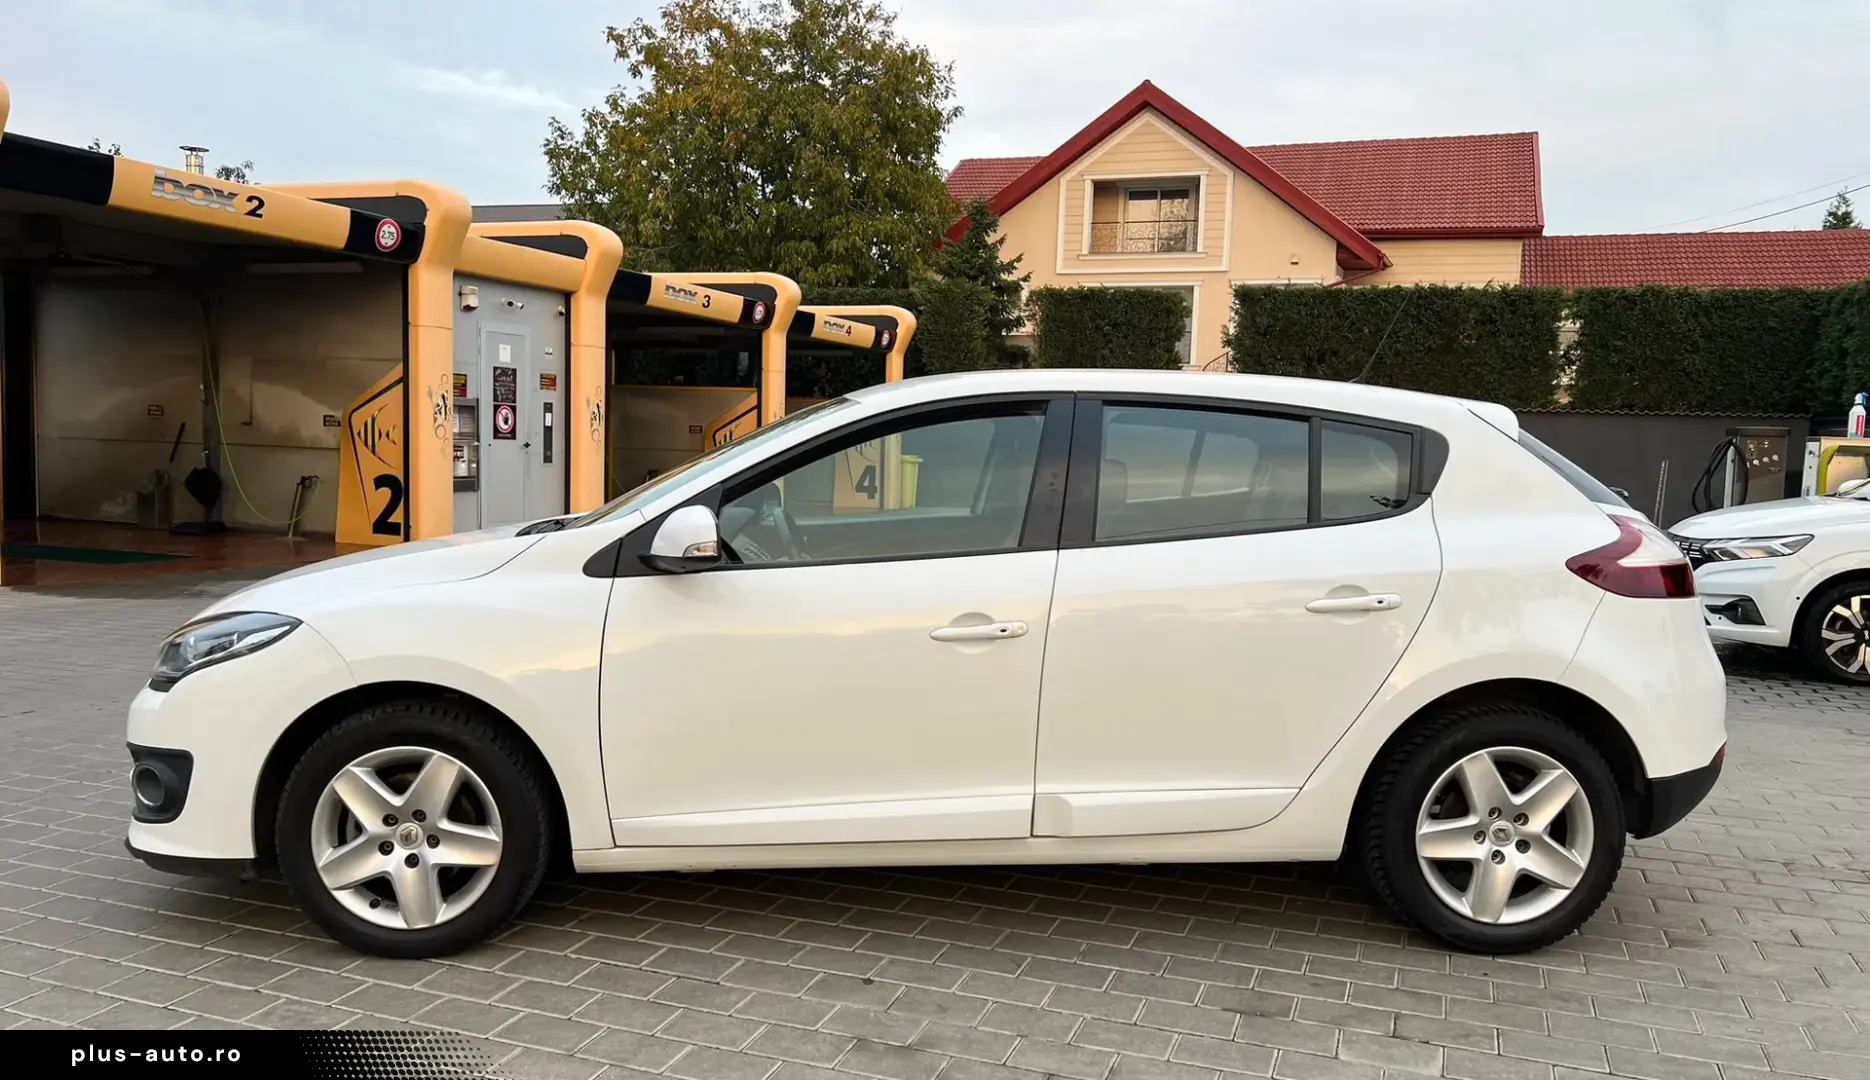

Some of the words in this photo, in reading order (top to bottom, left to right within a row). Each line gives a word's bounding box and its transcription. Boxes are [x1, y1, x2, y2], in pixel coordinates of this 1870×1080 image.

[244, 195, 265, 219] 2
[702, 294, 711, 309] 3
[845, 325, 852, 337] 4
[855, 464, 878, 500] 4
[372, 473, 404, 537] 2
